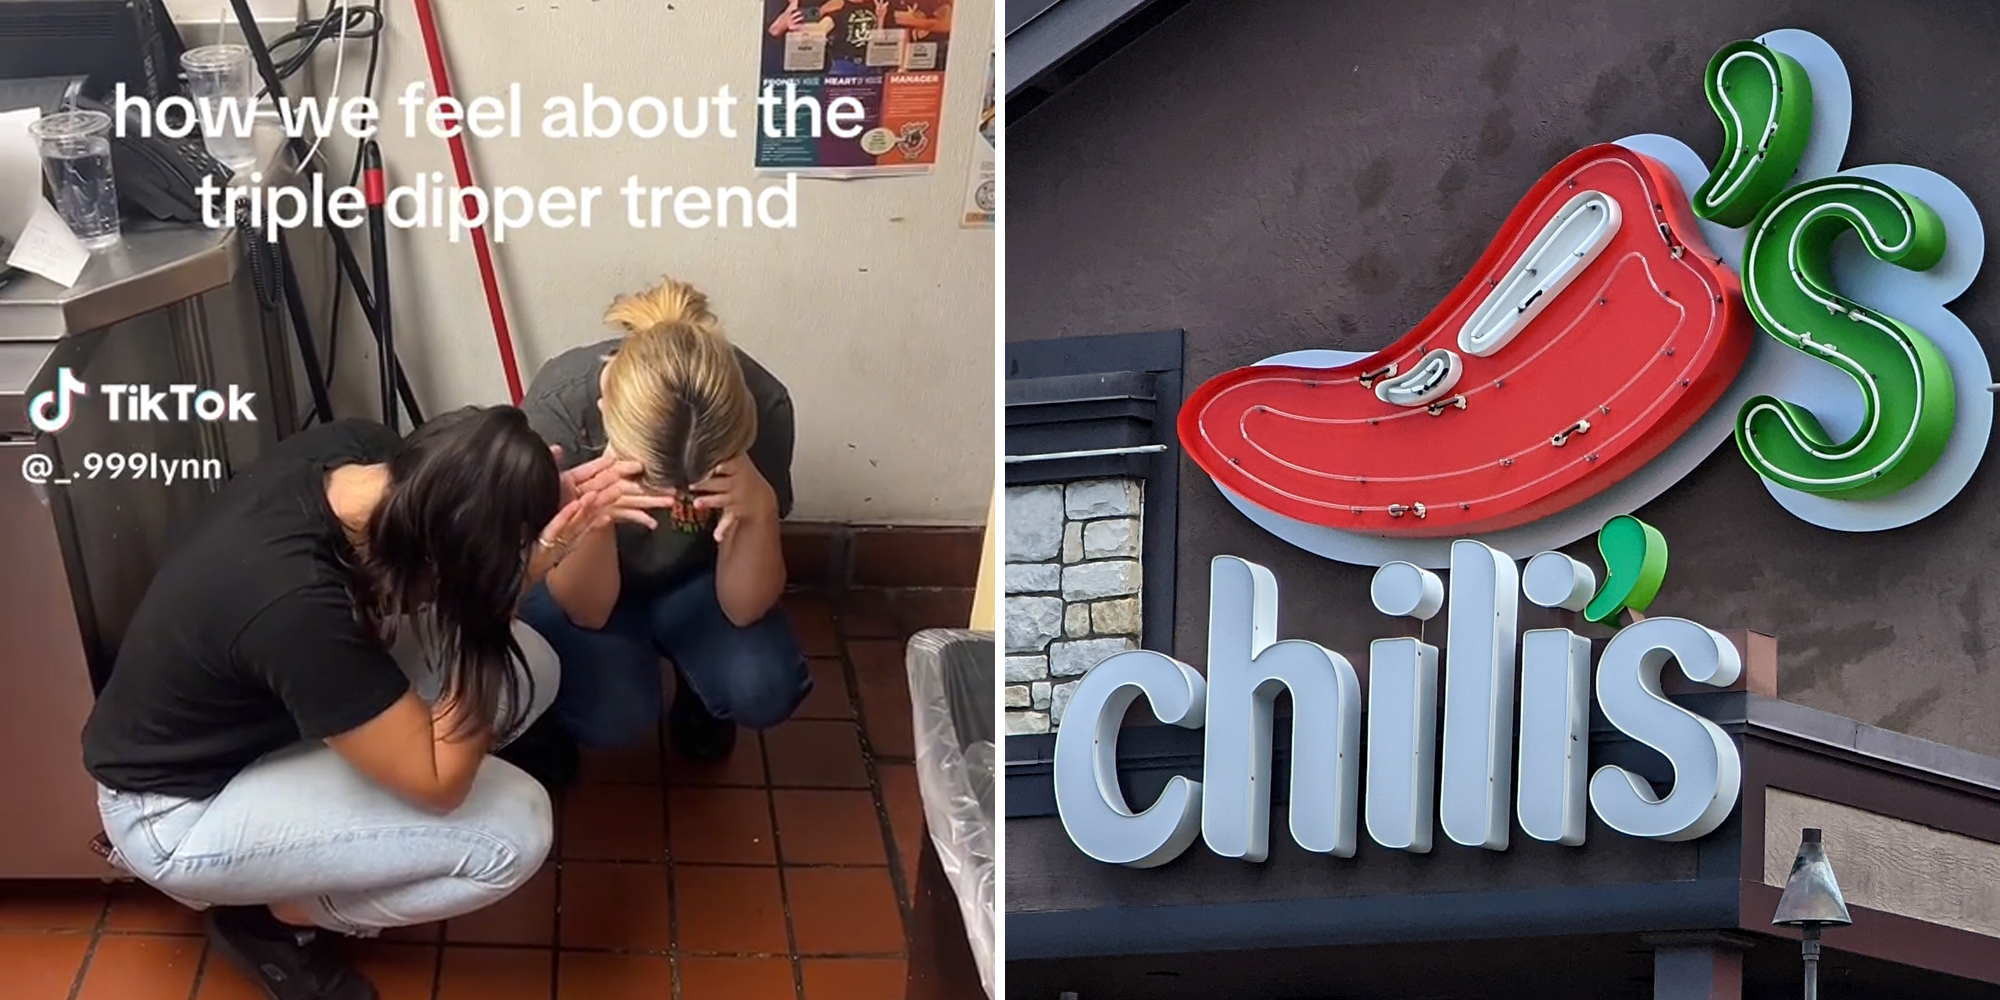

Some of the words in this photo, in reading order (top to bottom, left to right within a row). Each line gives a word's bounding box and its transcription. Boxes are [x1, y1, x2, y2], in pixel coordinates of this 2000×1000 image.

[824, 77, 858, 86] HEART
[890, 75, 940, 84] MANAGER
[1054, 514, 1742, 869] chili's
